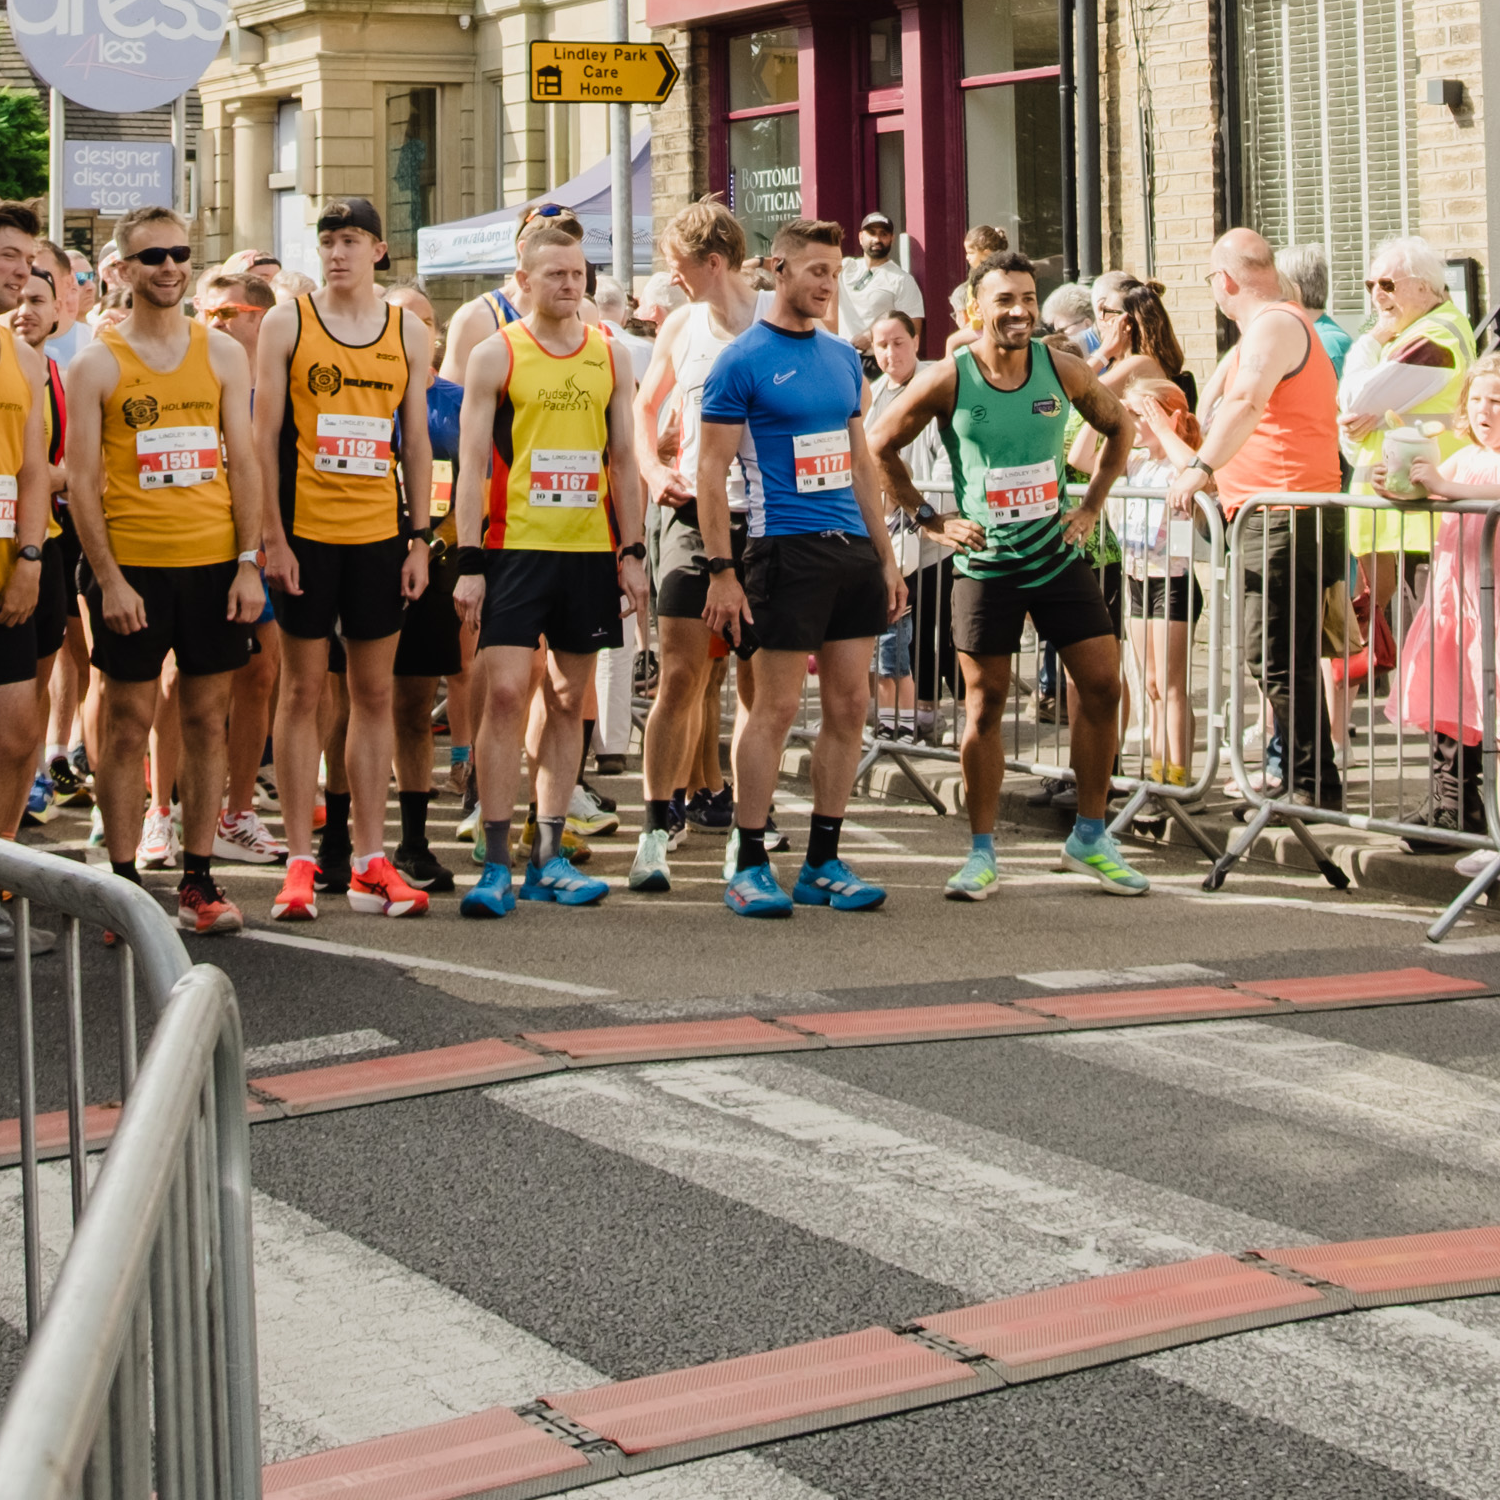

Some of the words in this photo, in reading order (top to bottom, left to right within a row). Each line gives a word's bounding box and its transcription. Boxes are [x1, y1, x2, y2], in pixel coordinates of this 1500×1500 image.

[553, 47, 608, 64] Lindley
[613, 46, 648, 62] Park
[582, 65, 619, 79] Care
[579, 82, 624, 98] Home
[73, 147, 161, 170] designer
[73, 168, 161, 188] discount
[741, 165, 803, 191] BOTTOML
[90, 189, 142, 208] store
[744, 190, 803, 214] OPTICIAN
[538, 388, 574, 403] Pudsey
[161, 401, 214, 412] HOLMFIRTH
[543, 400, 577, 412] Pacers
[336, 438, 377, 458] 1192
[158, 451, 200, 471] 1591
[814, 454, 845, 474] 1177
[550, 473, 589, 490] 1167
[1005, 470, 1029, 479] LINDLEY
[1005, 486, 1045, 506] 1415
